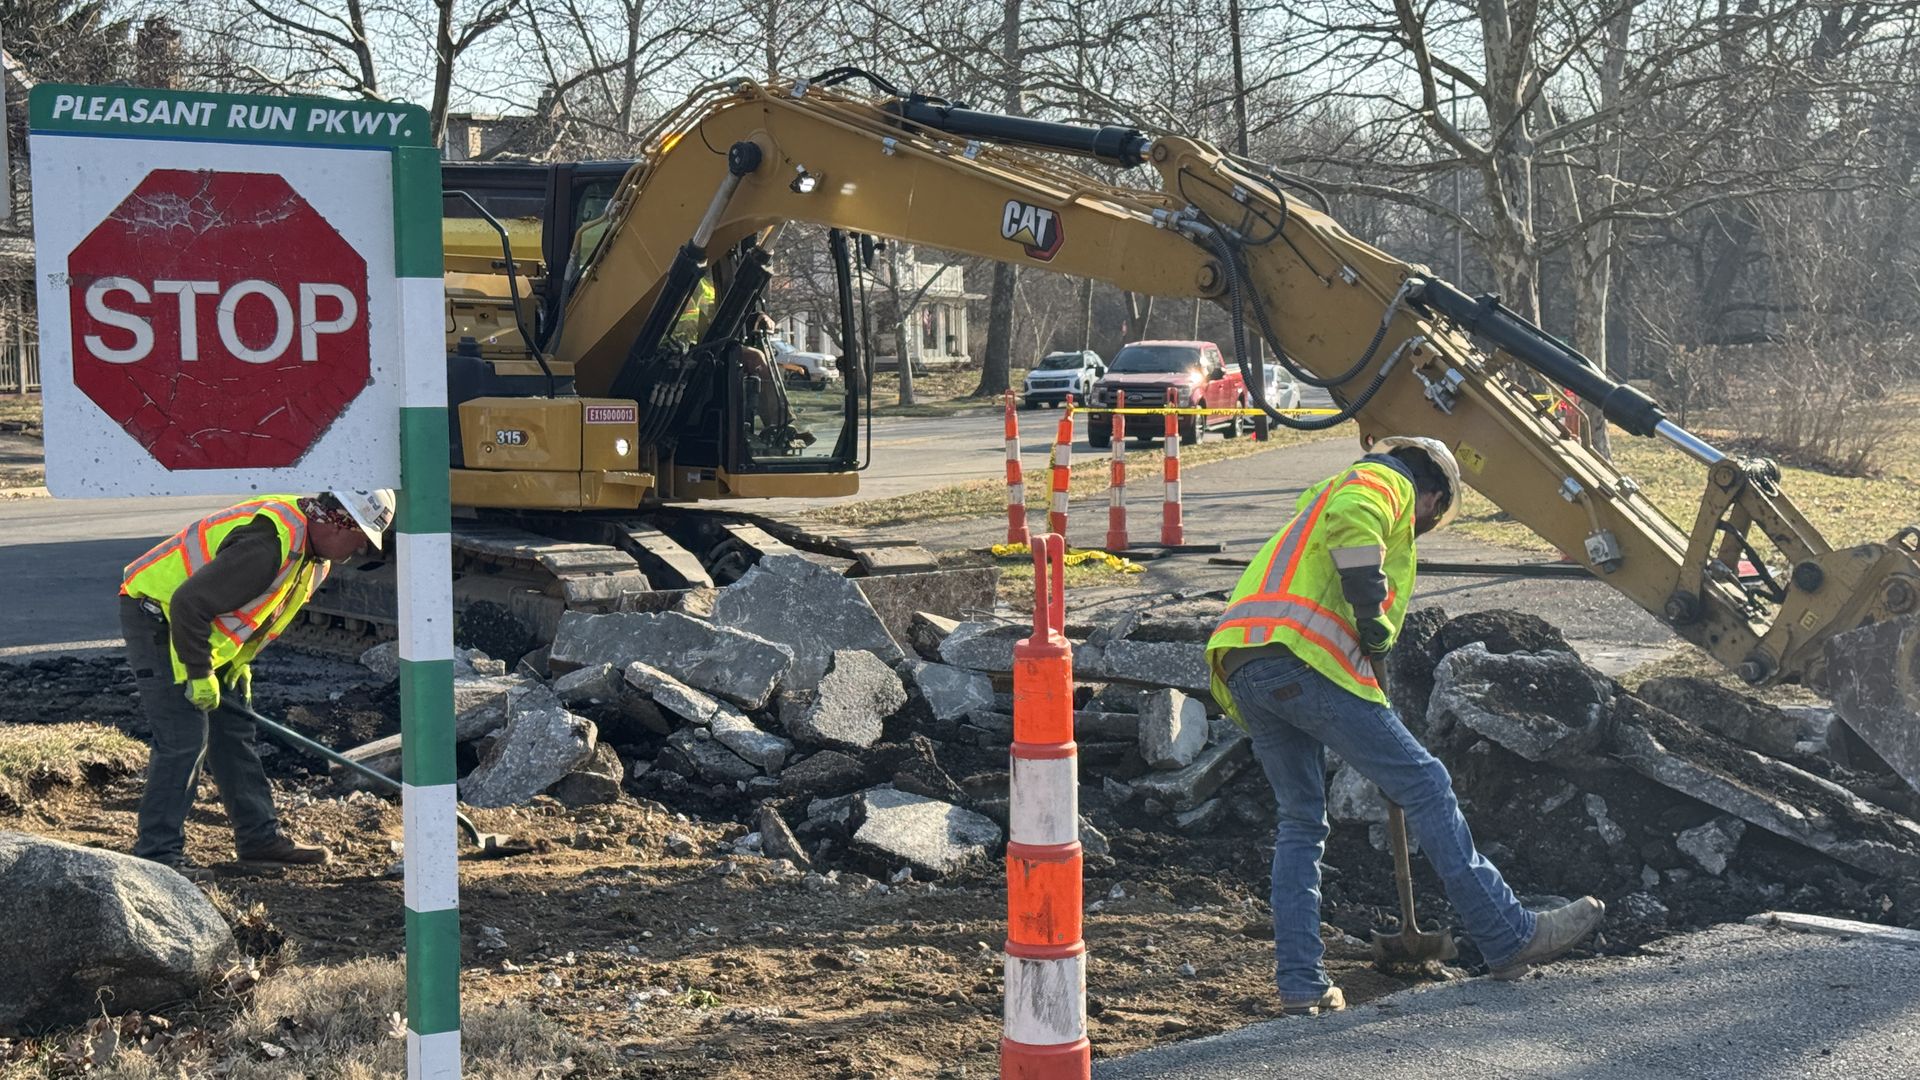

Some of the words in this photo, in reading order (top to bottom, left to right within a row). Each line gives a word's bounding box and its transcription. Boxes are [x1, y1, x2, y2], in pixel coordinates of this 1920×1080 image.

[52, 94, 217, 127] PLEASANT
[227, 104, 297, 131] RUN
[307, 108, 412, 137] PKWY.
[1002, 200, 1053, 248] CAT
[84, 276, 358, 364] STOP
[590, 408, 633, 421] EX15000013
[496, 430, 521, 445] 315
